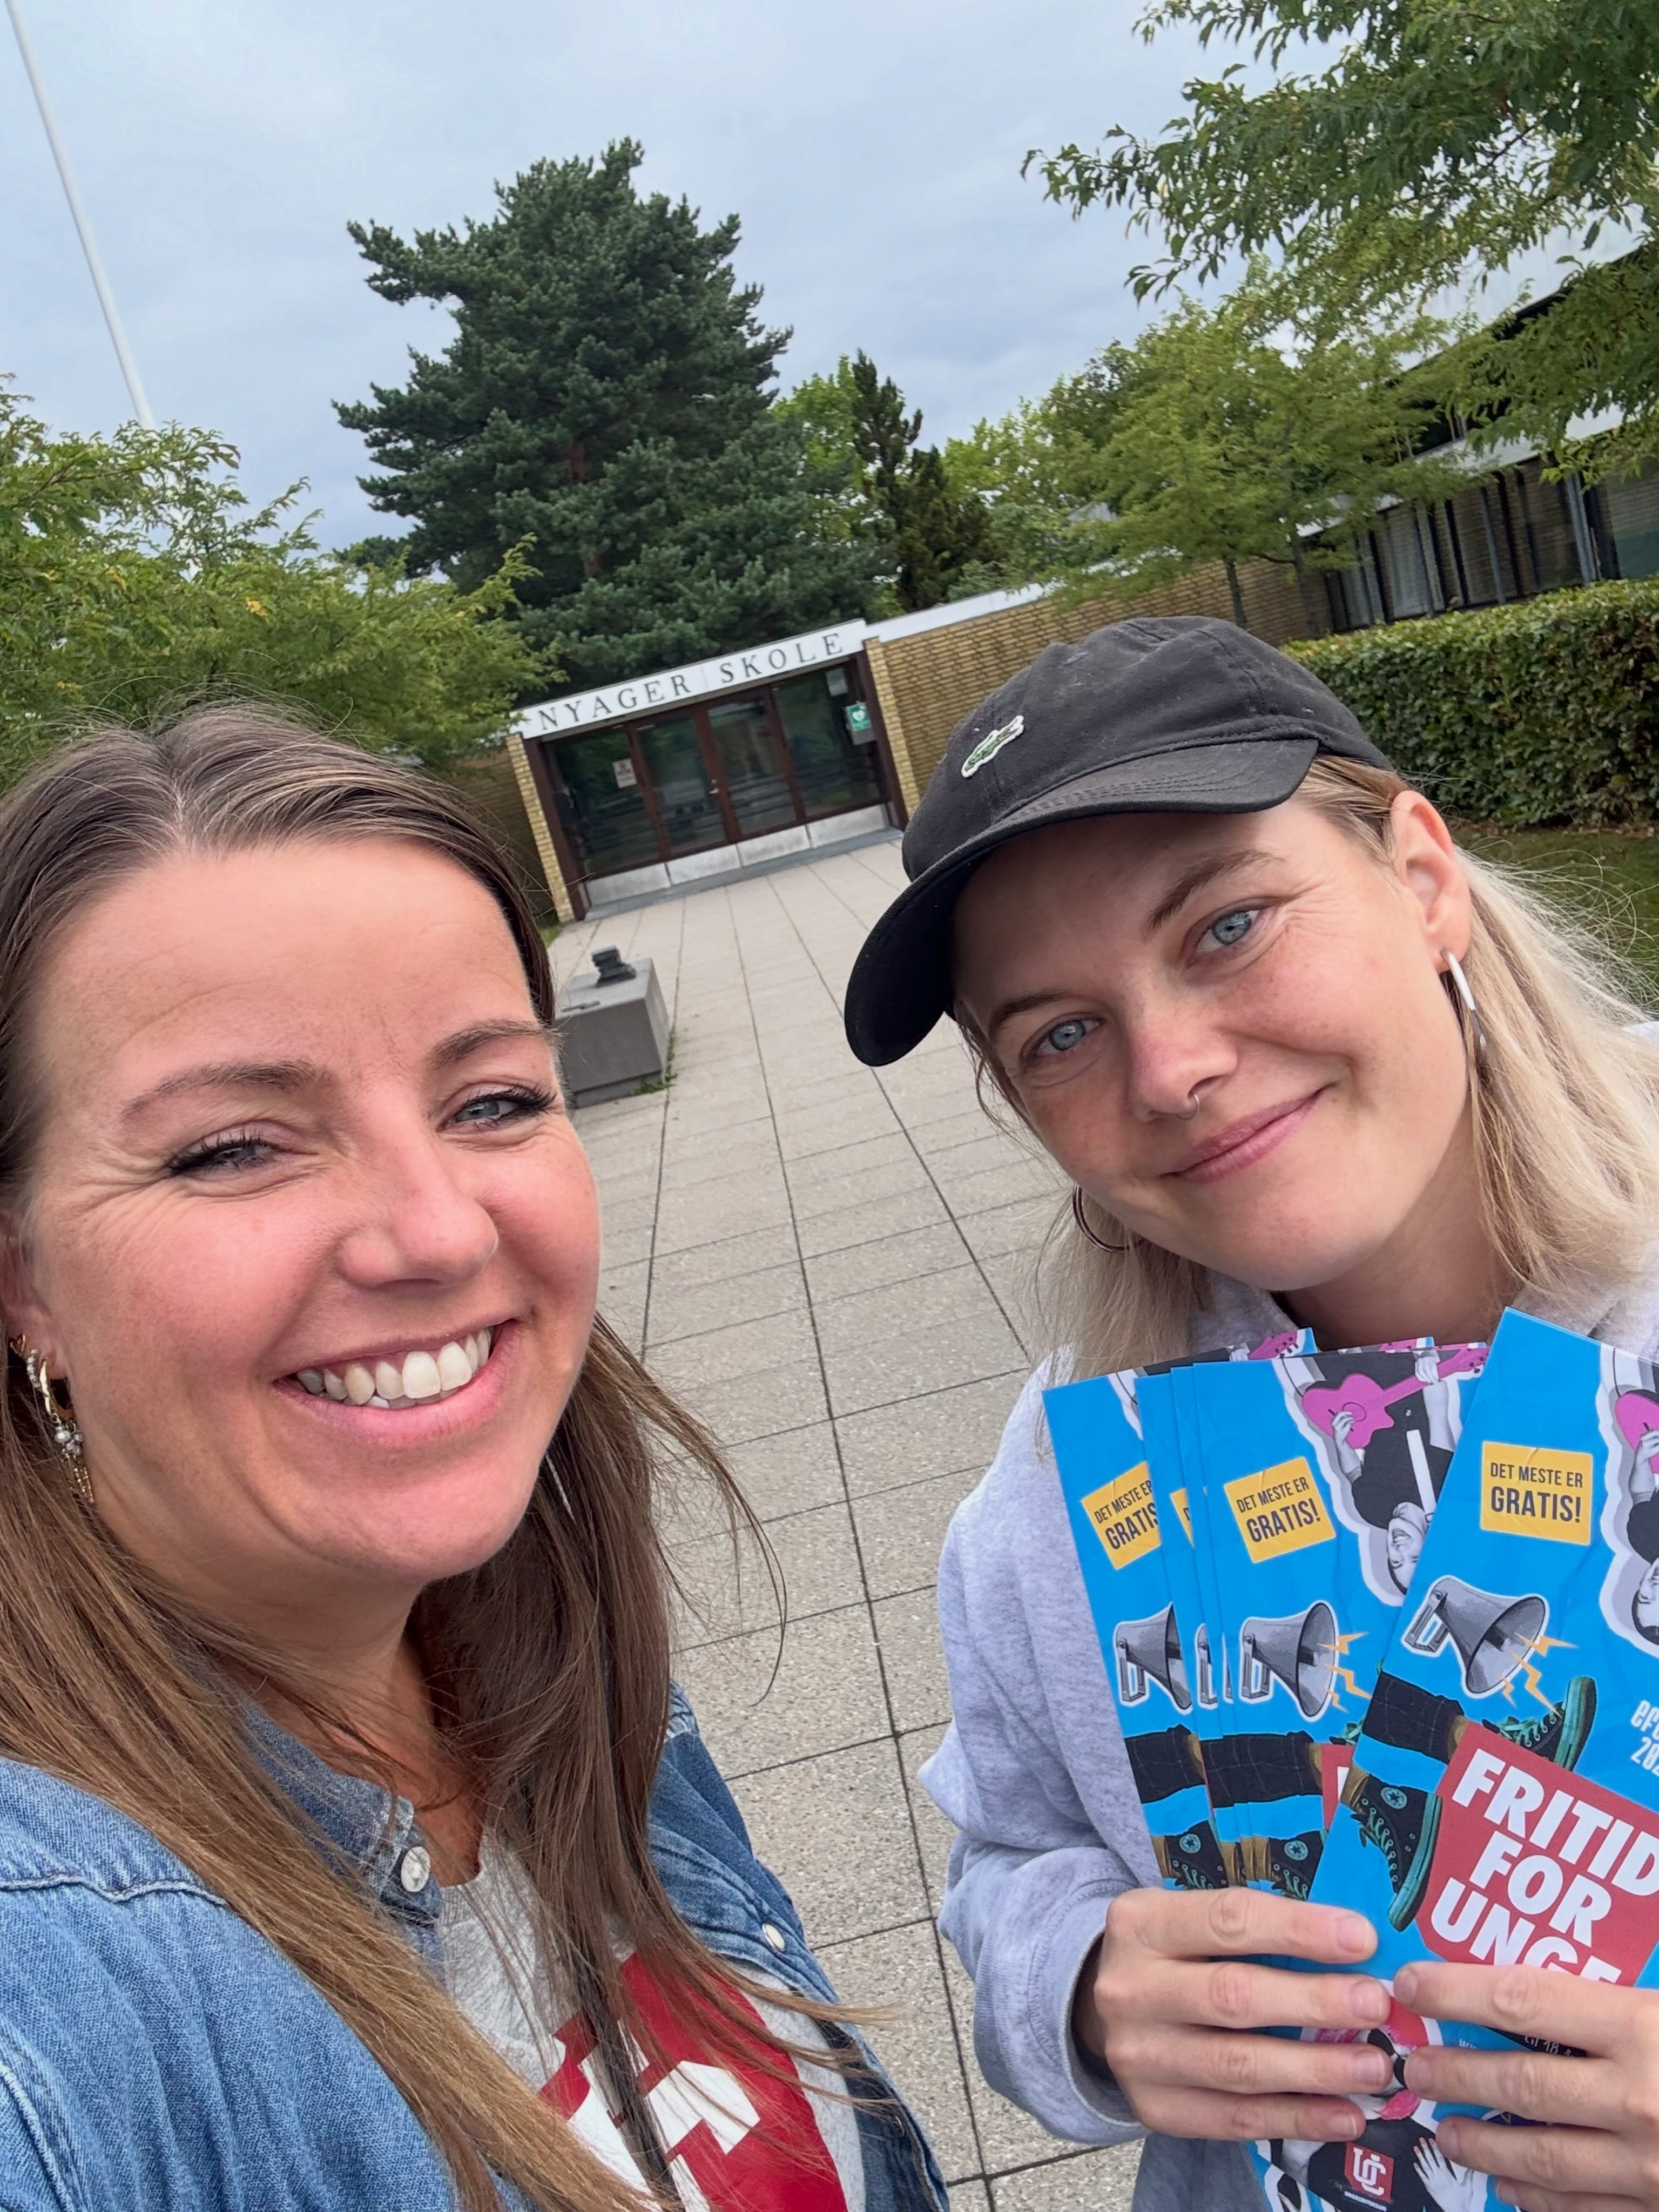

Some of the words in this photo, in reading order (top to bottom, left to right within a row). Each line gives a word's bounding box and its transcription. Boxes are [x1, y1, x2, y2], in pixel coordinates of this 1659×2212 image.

[537, 674, 691, 731] NYAGER
[720, 633, 843, 684] SKOLE
[1236, 1495, 1257, 1513] DET
[1258, 1482, 1293, 1506] MESTE
[1293, 1477, 1309, 1493] ER
[1491, 1462, 1514, 1479] DET
[1519, 1466, 1562, 1486] MESTE
[1567, 1472, 1583, 1488] ER
[1094, 1505, 1112, 1523] DET
[1111, 1487, 1142, 1513] MESTE
[1246, 1498, 1321, 1542] GRATIS!
[1491, 1486, 1581, 1523] GRATIS!
[1451, 1748, 1659, 1896] FRITID
[1469, 1830, 1612, 1948] FOR
